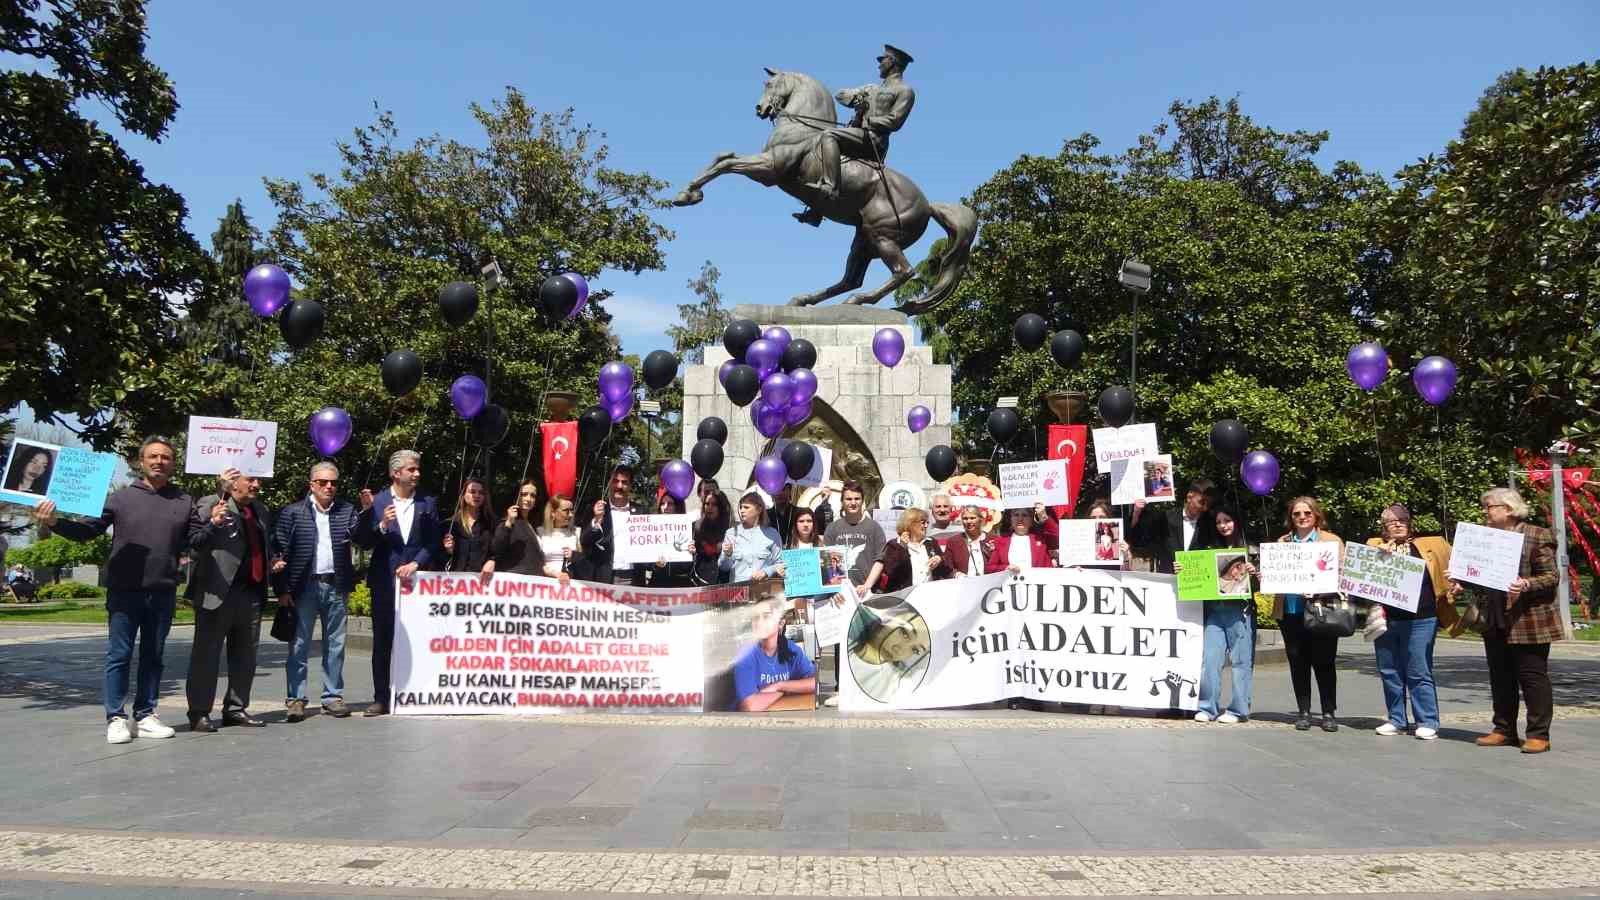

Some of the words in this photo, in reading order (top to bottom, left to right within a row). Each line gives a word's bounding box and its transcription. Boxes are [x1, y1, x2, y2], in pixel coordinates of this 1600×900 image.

[629, 533, 668, 546] KORK!
[1340, 579, 1355, 592] BU
[980, 575, 1149, 617] GÜLDEN
[428, 602, 450, 617] 30
[455, 602, 505, 619] BIÇAK
[509, 604, 608, 623] DARBESİNİN
[465, 620, 473, 634] 1
[478, 621, 532, 636] YILDIR
[535, 623, 638, 639] SORULMADI!
[429, 635, 497, 654] GÜLDEN
[502, 635, 534, 656] İÇİN
[538, 639, 604, 655] ADALET
[608, 642, 669, 657] GELENE
[952, 626, 1009, 663] için
[1017, 622, 1187, 659] ADALET
[446, 656, 505, 671] KADAR
[509, 657, 654, 674] SOKAKLARDAYIZ.
[438, 674, 461, 688] BU
[465, 674, 515, 688] KANLI
[521, 675, 576, 690] HESAP
[1005, 659, 1128, 694] istiyoruz
[593, 692, 703, 709] KAPANACAK!
